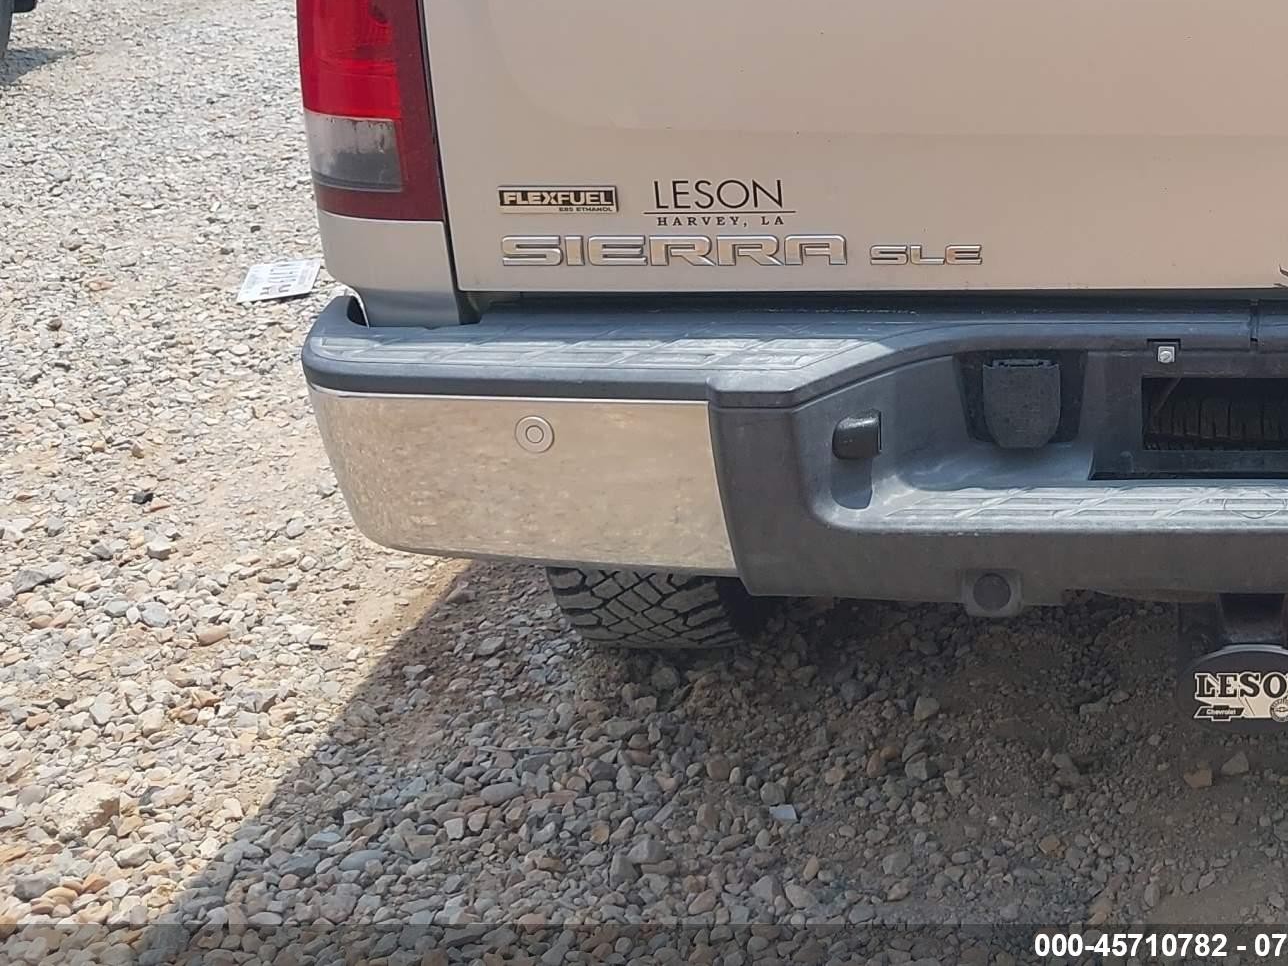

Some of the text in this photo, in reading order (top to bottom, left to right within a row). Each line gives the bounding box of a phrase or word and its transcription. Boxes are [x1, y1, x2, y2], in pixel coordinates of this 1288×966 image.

[502, 191, 612, 205] FLEXFUEL
[653, 179, 783, 209] LESON
[657, 216, 784, 227] HARVEY, LA
[501, 234, 848, 267] SIERRA
[869, 243, 983, 266] SLE
